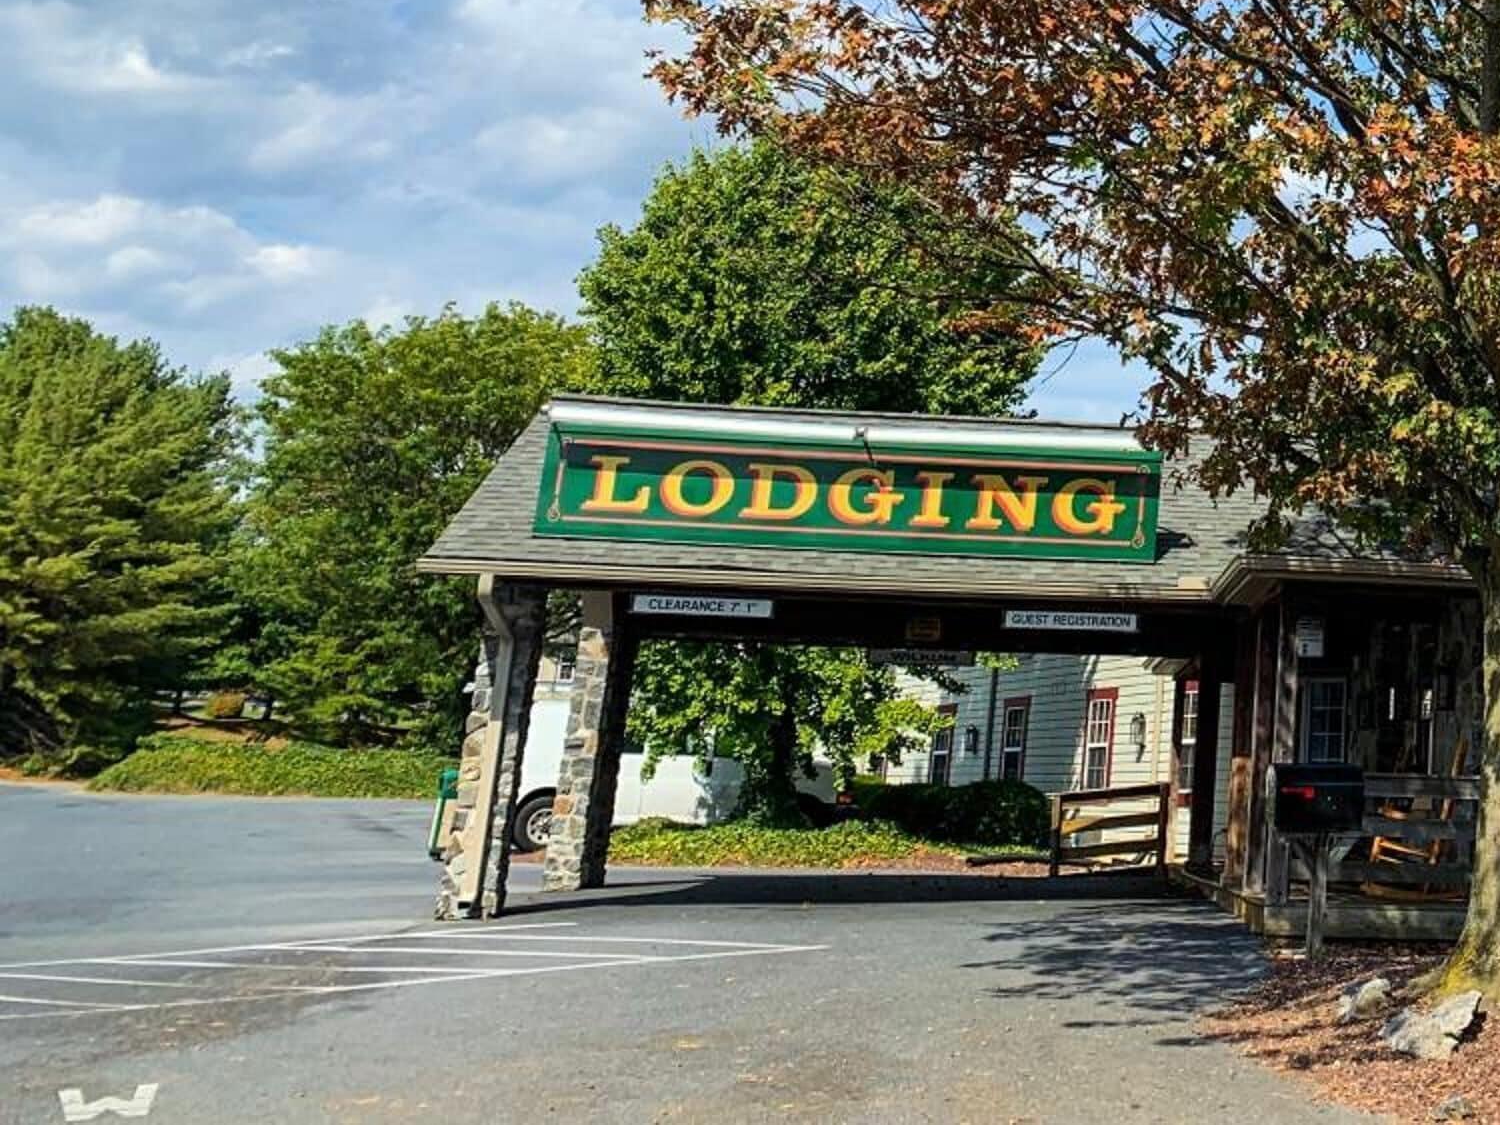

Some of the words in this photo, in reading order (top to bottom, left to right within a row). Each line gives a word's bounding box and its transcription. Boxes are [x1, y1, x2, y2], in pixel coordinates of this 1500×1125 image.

[580, 454, 1126, 535] LODGING
[648, 598, 725, 612] CLEARANCE
[1011, 614, 1049, 625] GUEST
[1053, 615, 1131, 628] REGISTRATION
